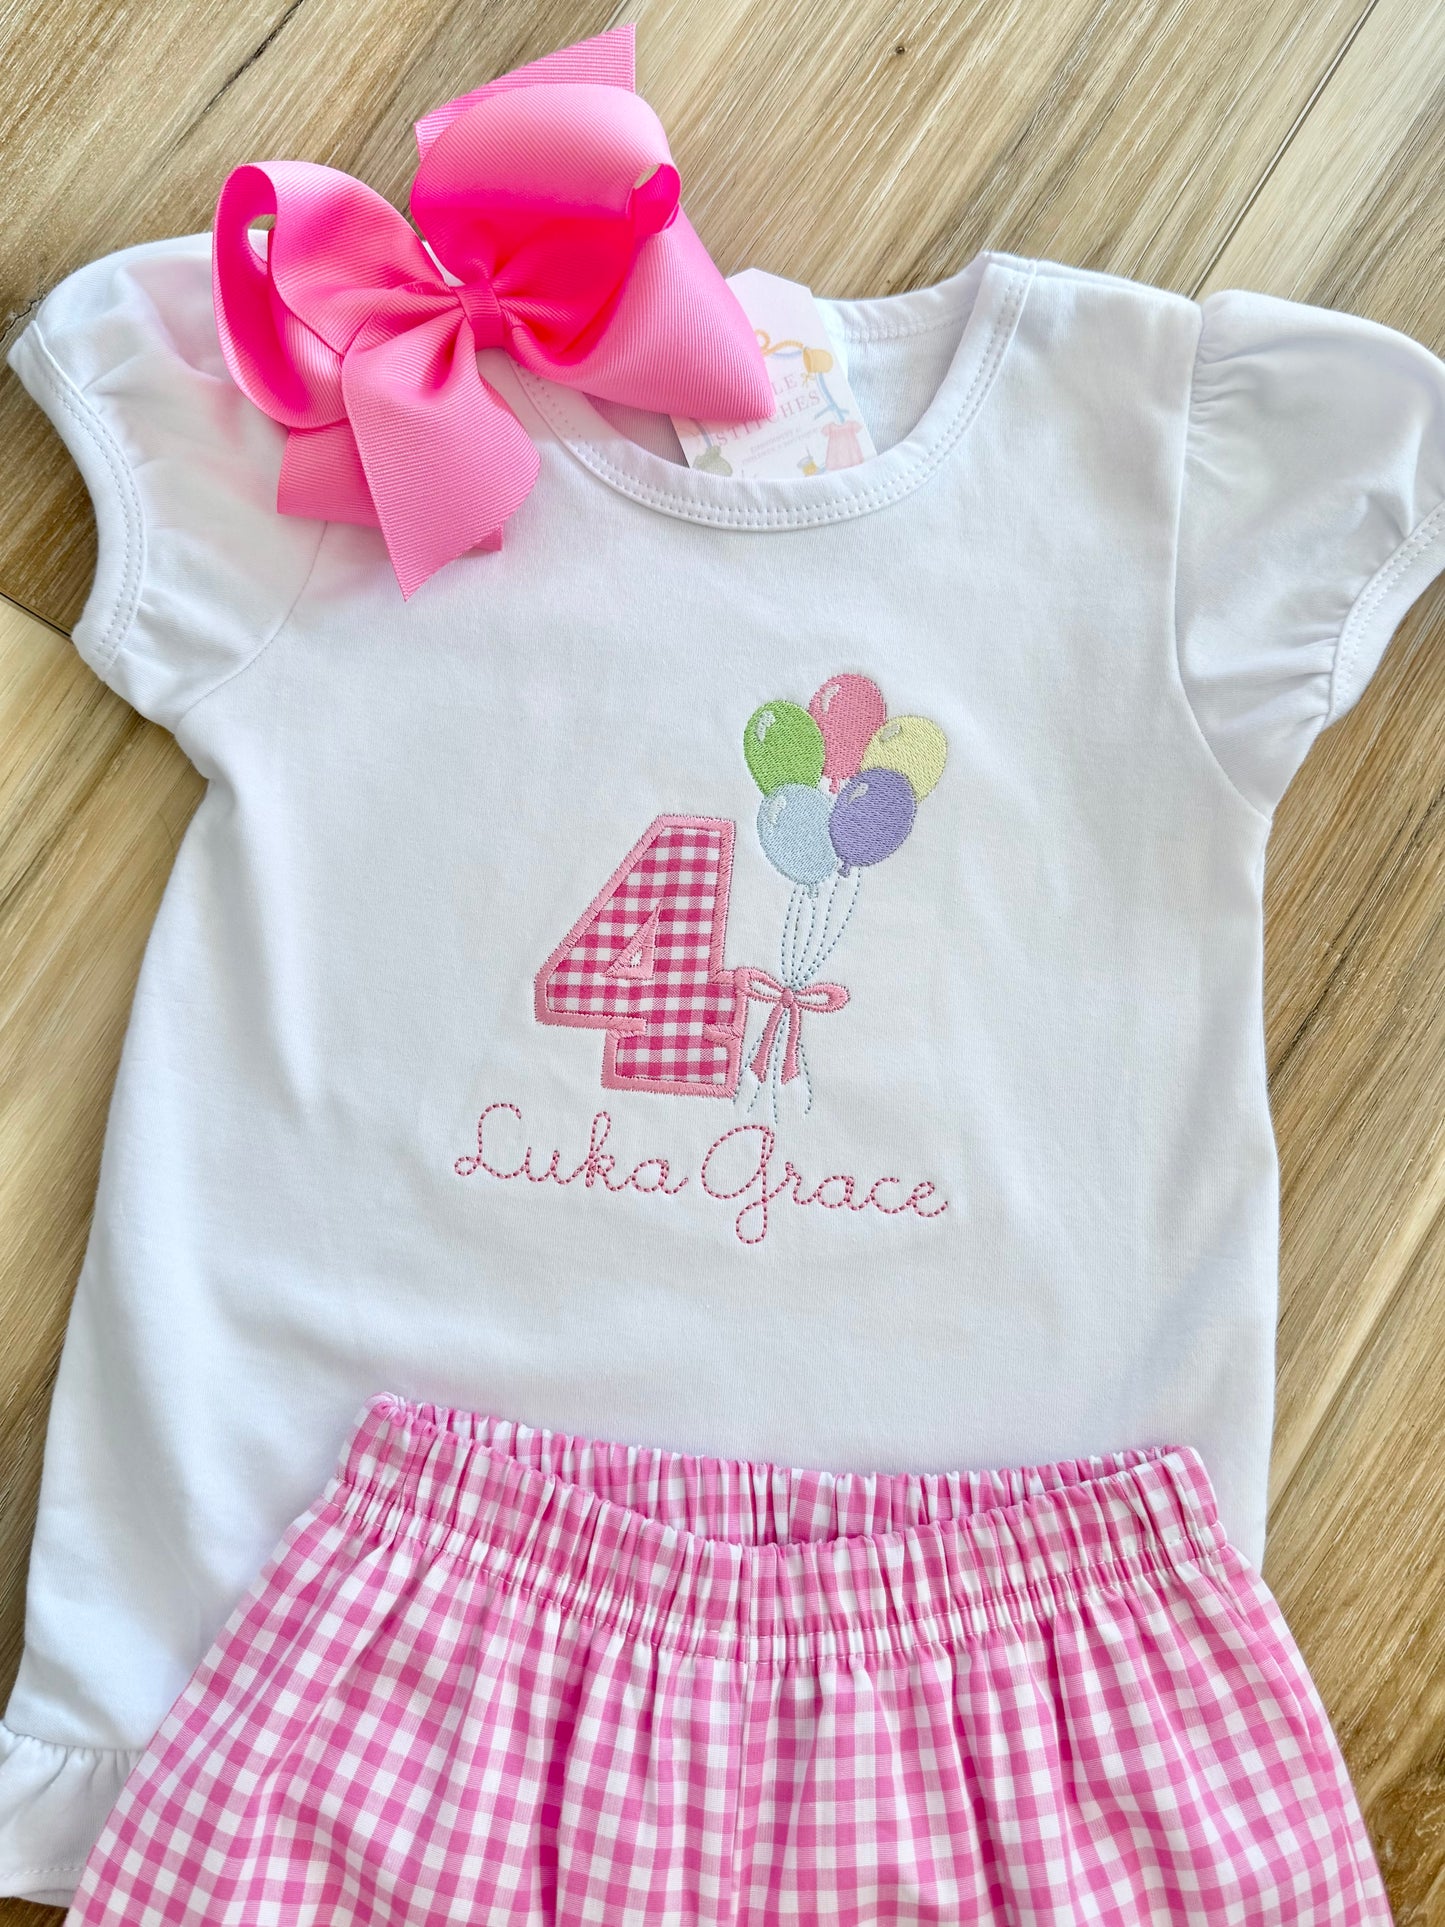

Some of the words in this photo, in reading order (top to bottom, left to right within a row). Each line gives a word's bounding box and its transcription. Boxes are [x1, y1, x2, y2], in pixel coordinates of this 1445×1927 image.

[534, 814, 747, 1099] 4
[454, 1102, 690, 1195] Luka
[700, 1124, 949, 1244] Grace
